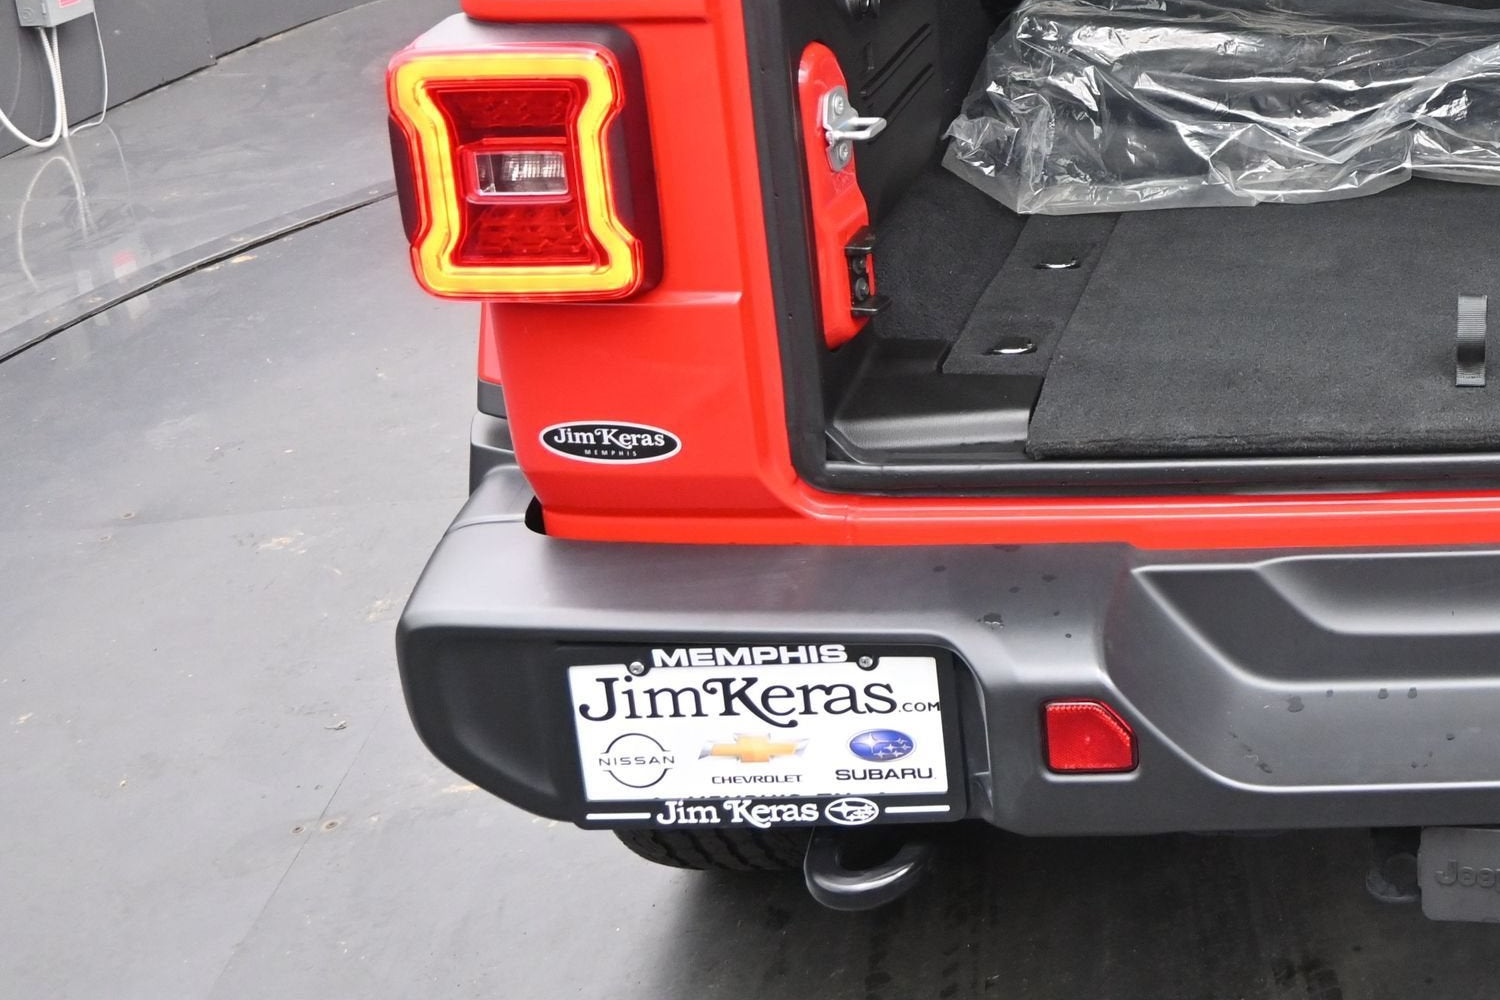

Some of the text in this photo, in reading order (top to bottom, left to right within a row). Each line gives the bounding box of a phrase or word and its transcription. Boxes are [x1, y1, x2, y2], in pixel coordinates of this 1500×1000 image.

[584, 449, 637, 457] MEMPHIS
[651, 644, 848, 667] MEMPHIS
[598, 756, 675, 767] NISSAN
[712, 774, 803, 785] CHEVROLET
[835, 767, 933, 781] SUBARU
